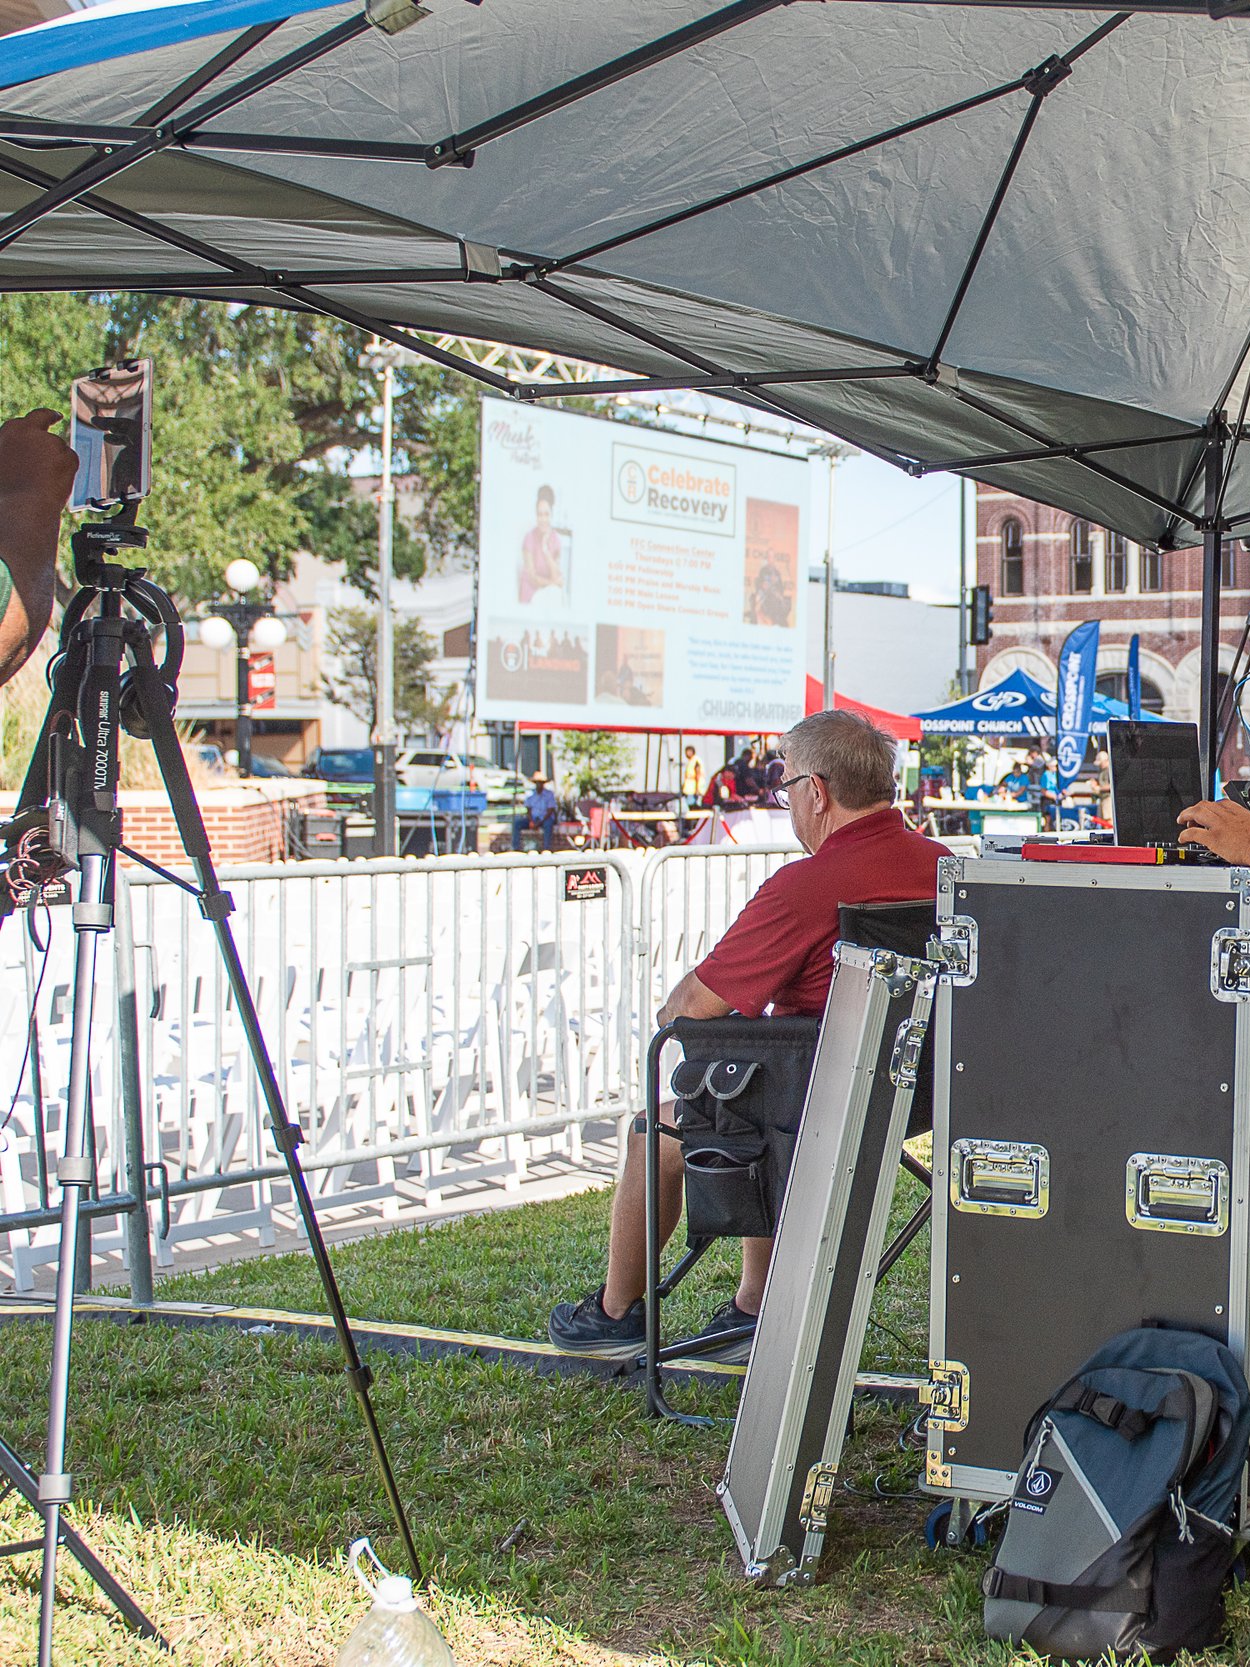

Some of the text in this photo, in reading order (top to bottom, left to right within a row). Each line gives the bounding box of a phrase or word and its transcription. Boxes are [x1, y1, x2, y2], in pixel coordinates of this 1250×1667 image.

[647, 464, 730, 497] Celebrate
[647, 488, 728, 523] Recovery
[1061, 651, 1081, 731] CROSSPOINT
[701, 698, 752, 719] CHURCH
[97, 721, 111, 747] Ultra
[977, 720, 1022, 732] CHURCH
[1014, 1500, 1044, 1513] VOLCOM
